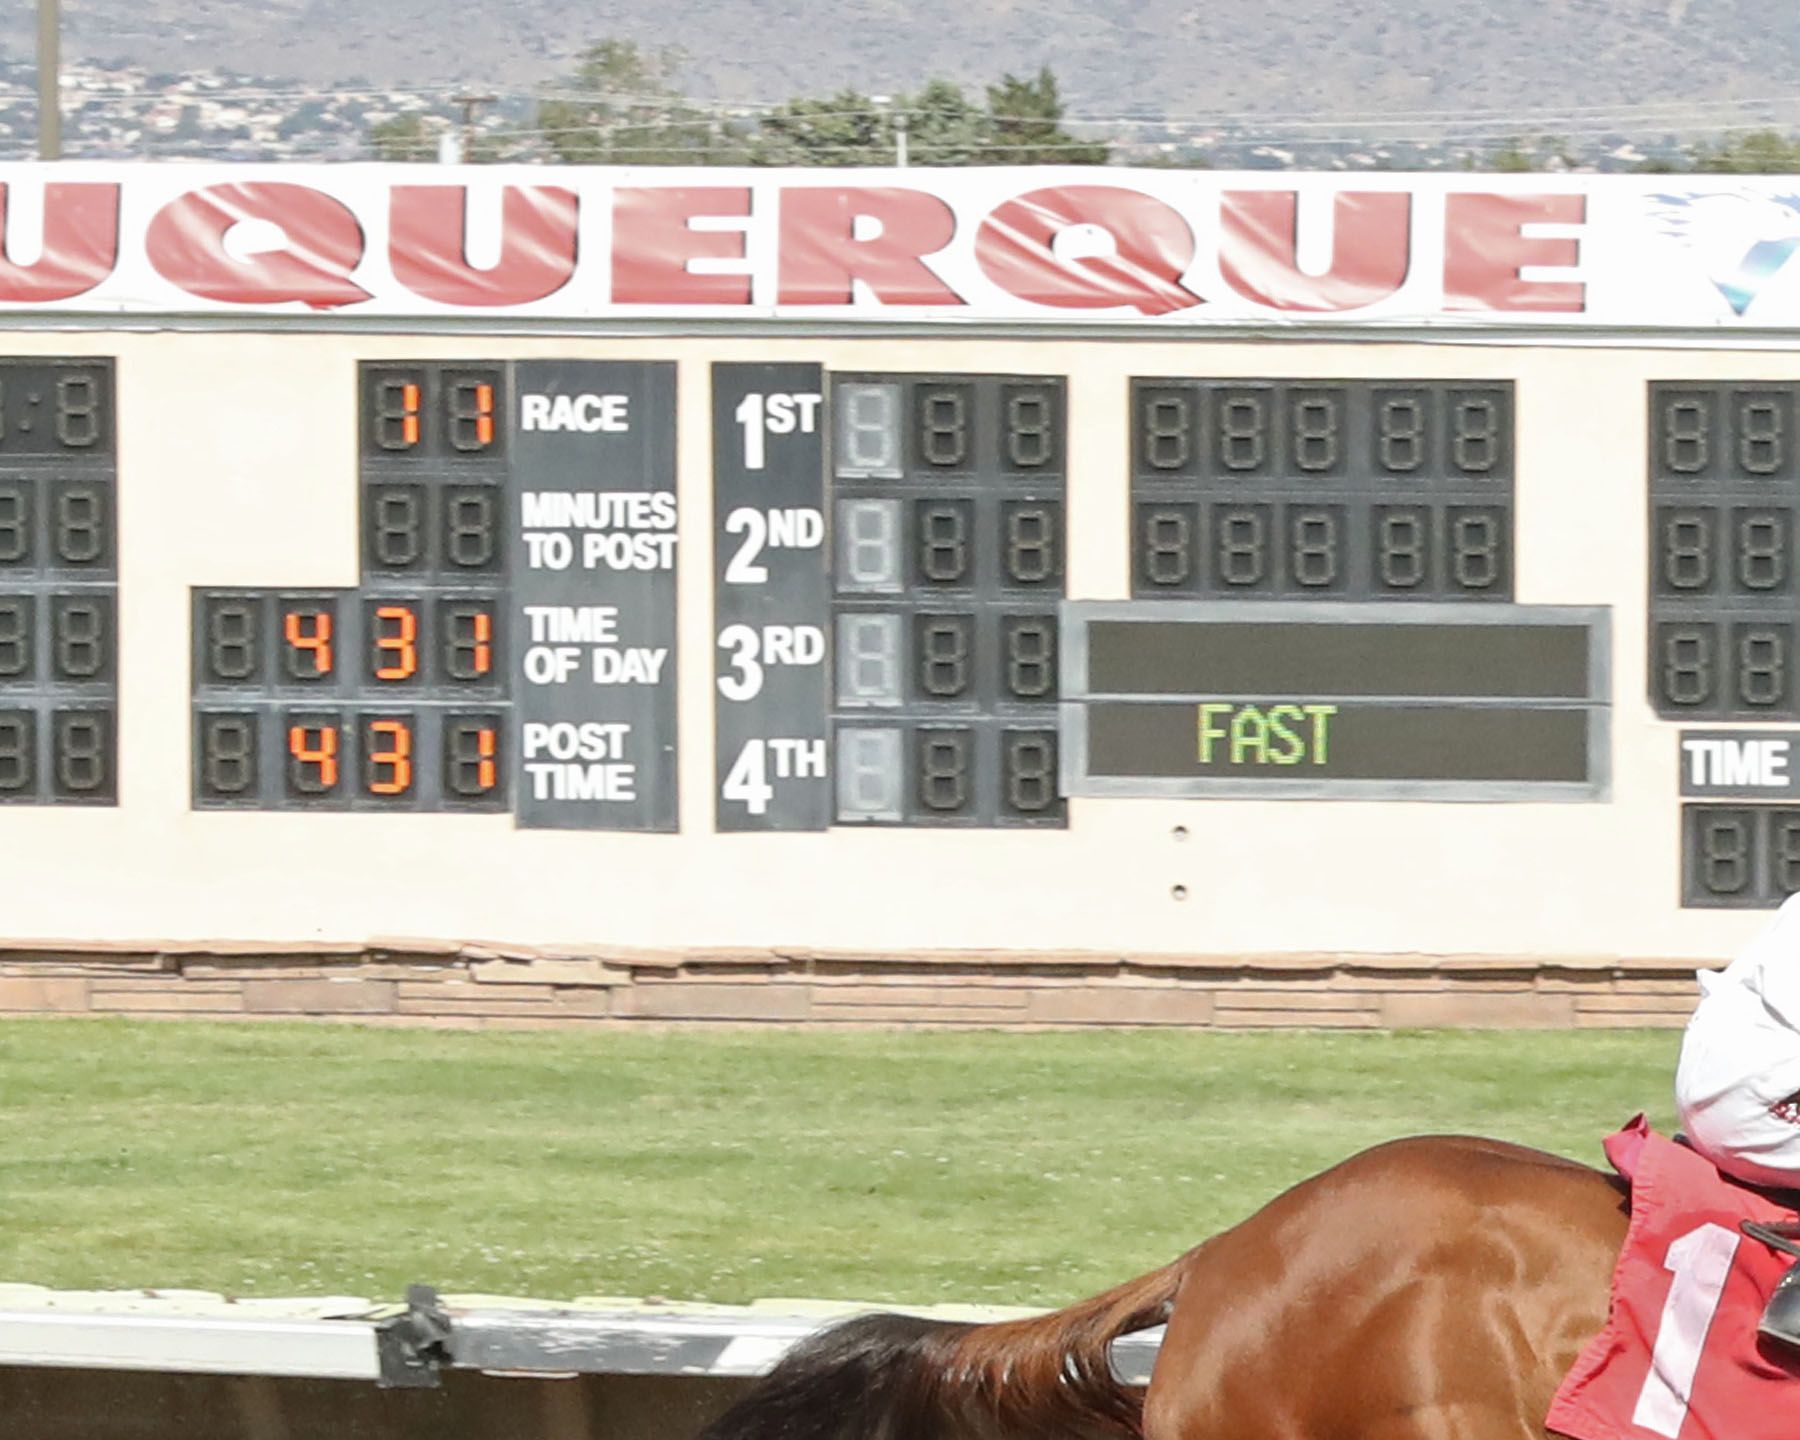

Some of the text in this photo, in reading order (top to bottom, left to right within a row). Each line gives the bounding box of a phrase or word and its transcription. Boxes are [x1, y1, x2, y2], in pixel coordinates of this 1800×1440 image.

[521, 394, 629, 432] RACE
[735, 393, 822, 469] 1ST
[521, 491, 677, 529] MINUTES
[521, 532, 679, 570] TO POST
[725, 507, 824, 583] 2ND
[523, 606, 618, 643] TIME
[523, 646, 668, 685] OF DAY
[716, 624, 825, 701] 3RD
[522, 722, 631, 760] POST
[1198, 703, 1338, 766] FAST
[524, 763, 636, 801] TIME
[722, 739, 827, 814] 4TH
[1683, 740, 1790, 788] TIME
[1632, 1221, 1741, 1440] 1
